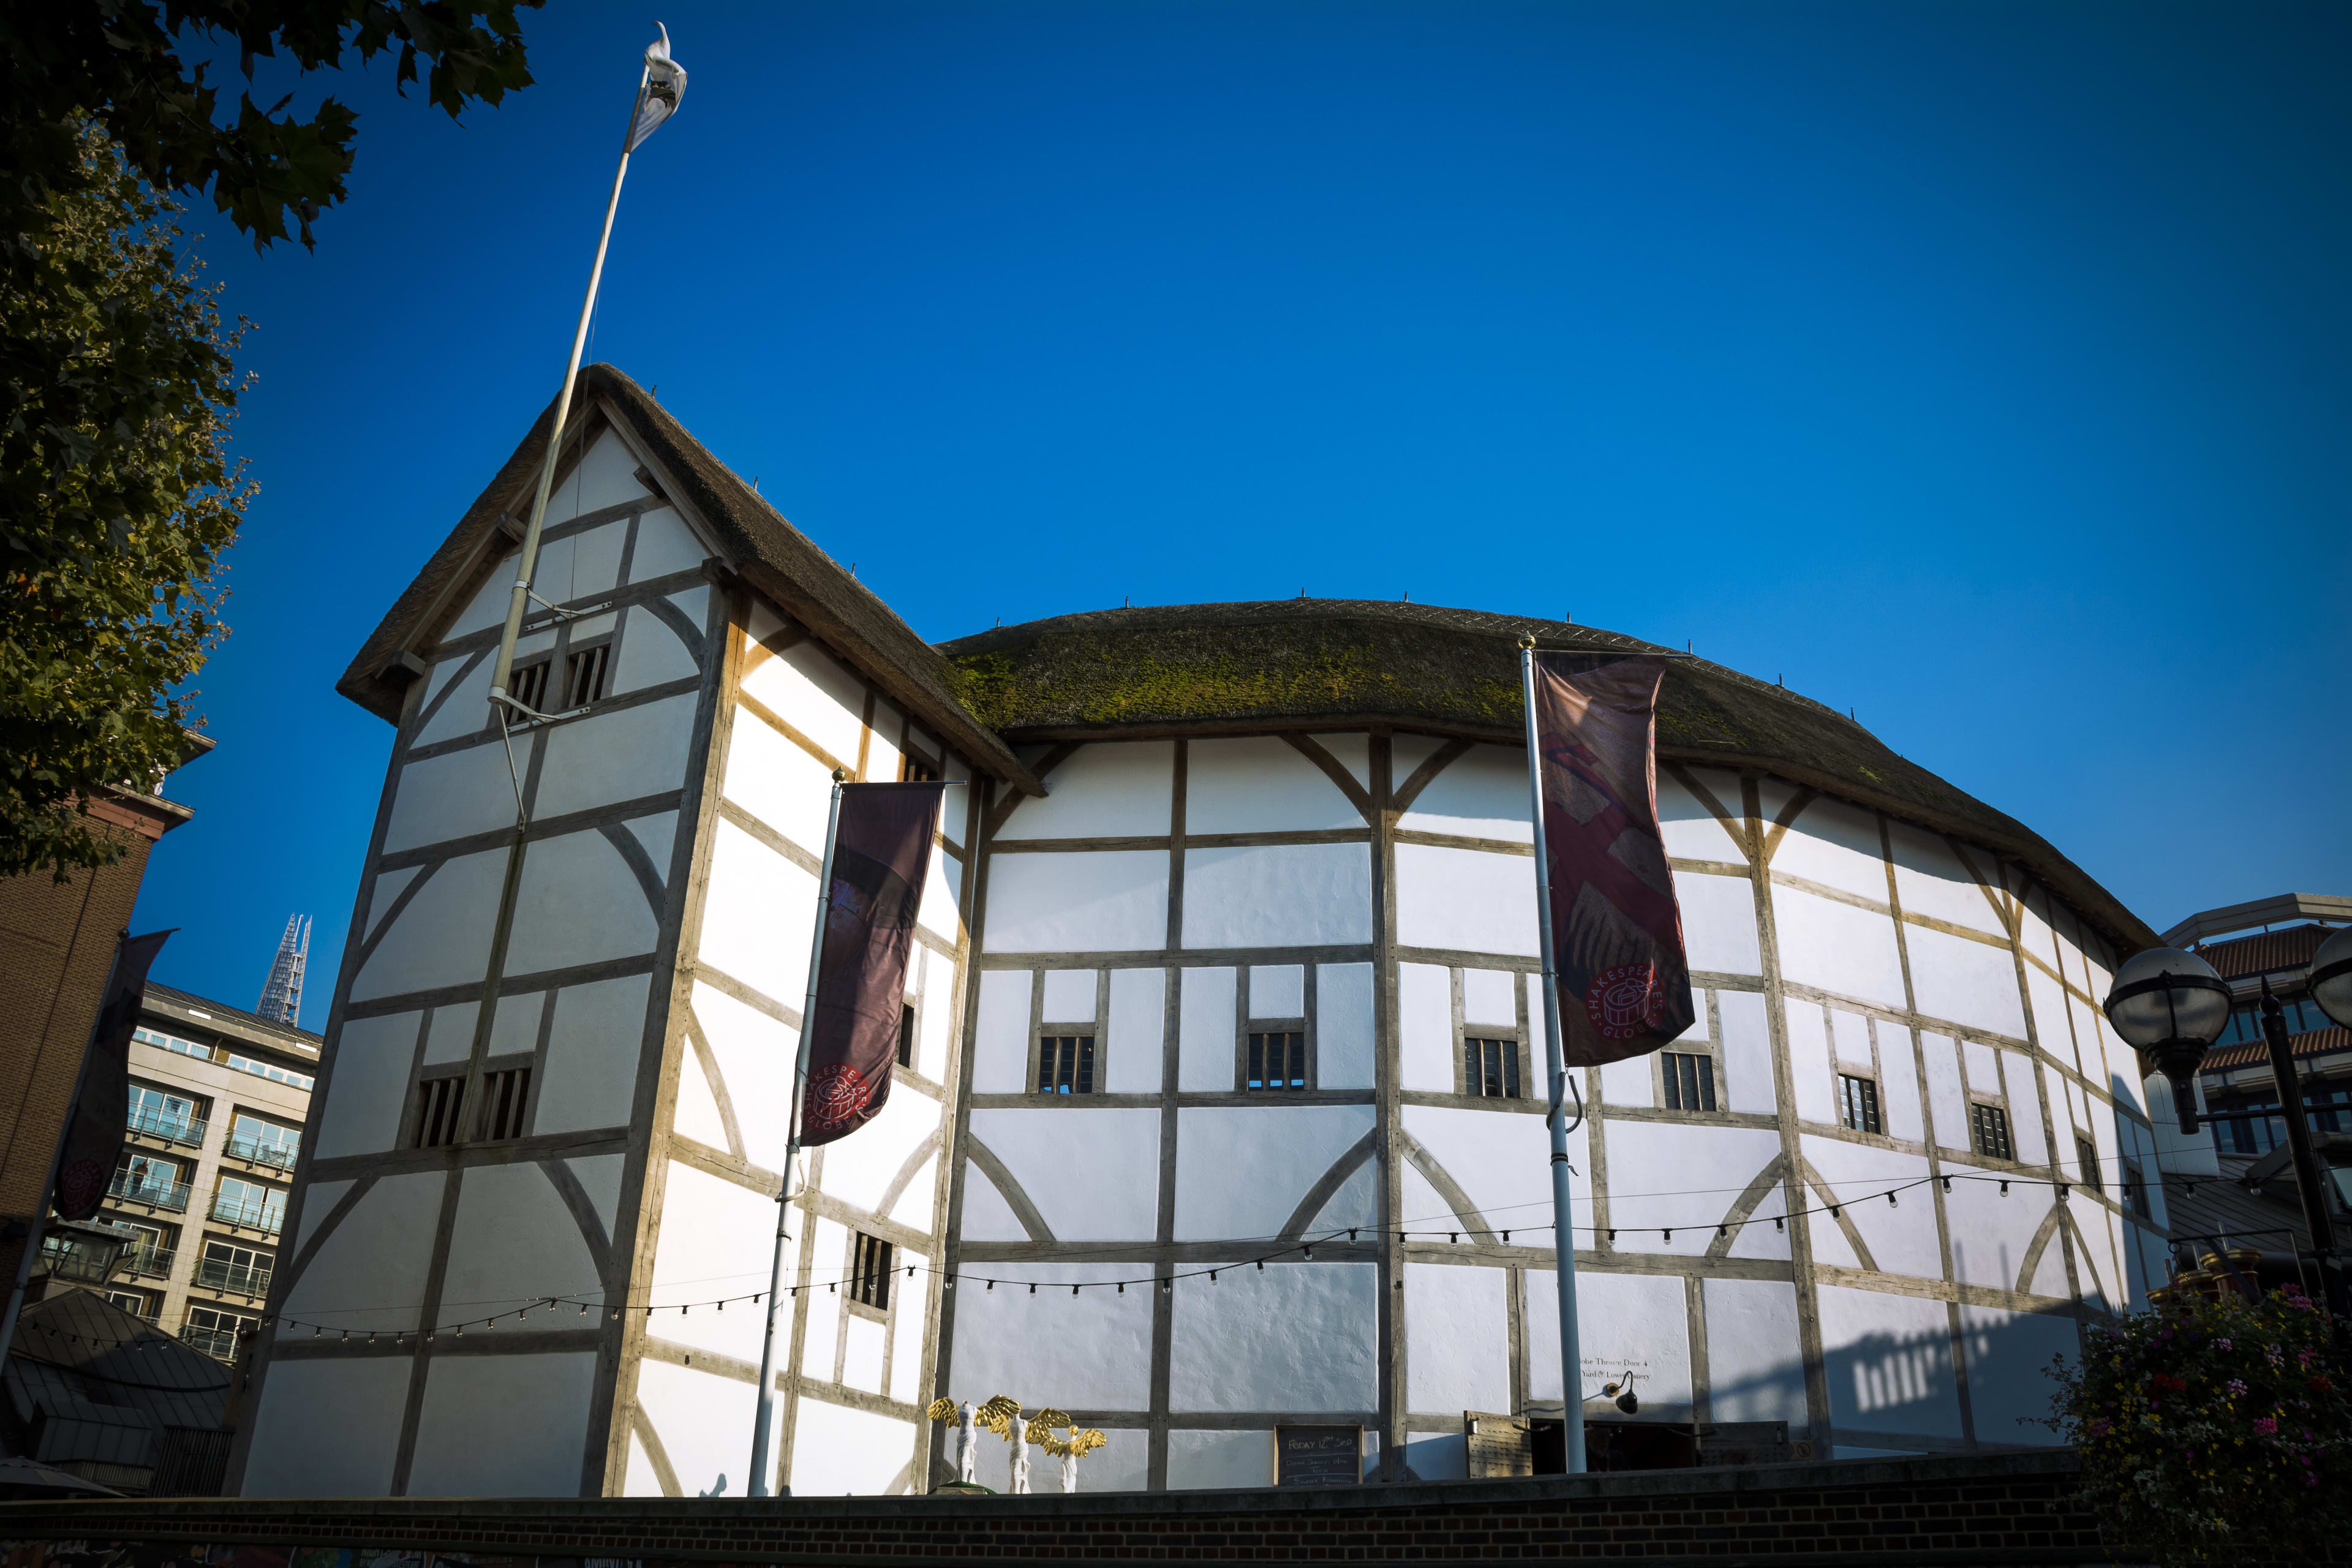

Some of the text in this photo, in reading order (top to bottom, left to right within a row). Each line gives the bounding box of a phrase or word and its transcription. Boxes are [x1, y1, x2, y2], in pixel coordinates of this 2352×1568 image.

[1588, 965, 1663, 1020] SHAKESPEARE'S
[1603, 1017, 1656, 1039] GLOBE
[804, 1065, 867, 1112] SHAKESPEARE'S
[808, 1115, 852, 1130] GLOBE
[1624, 1359, 1641, 1367] Door
[1289, 1439, 1316, 1450] FRIDAY
